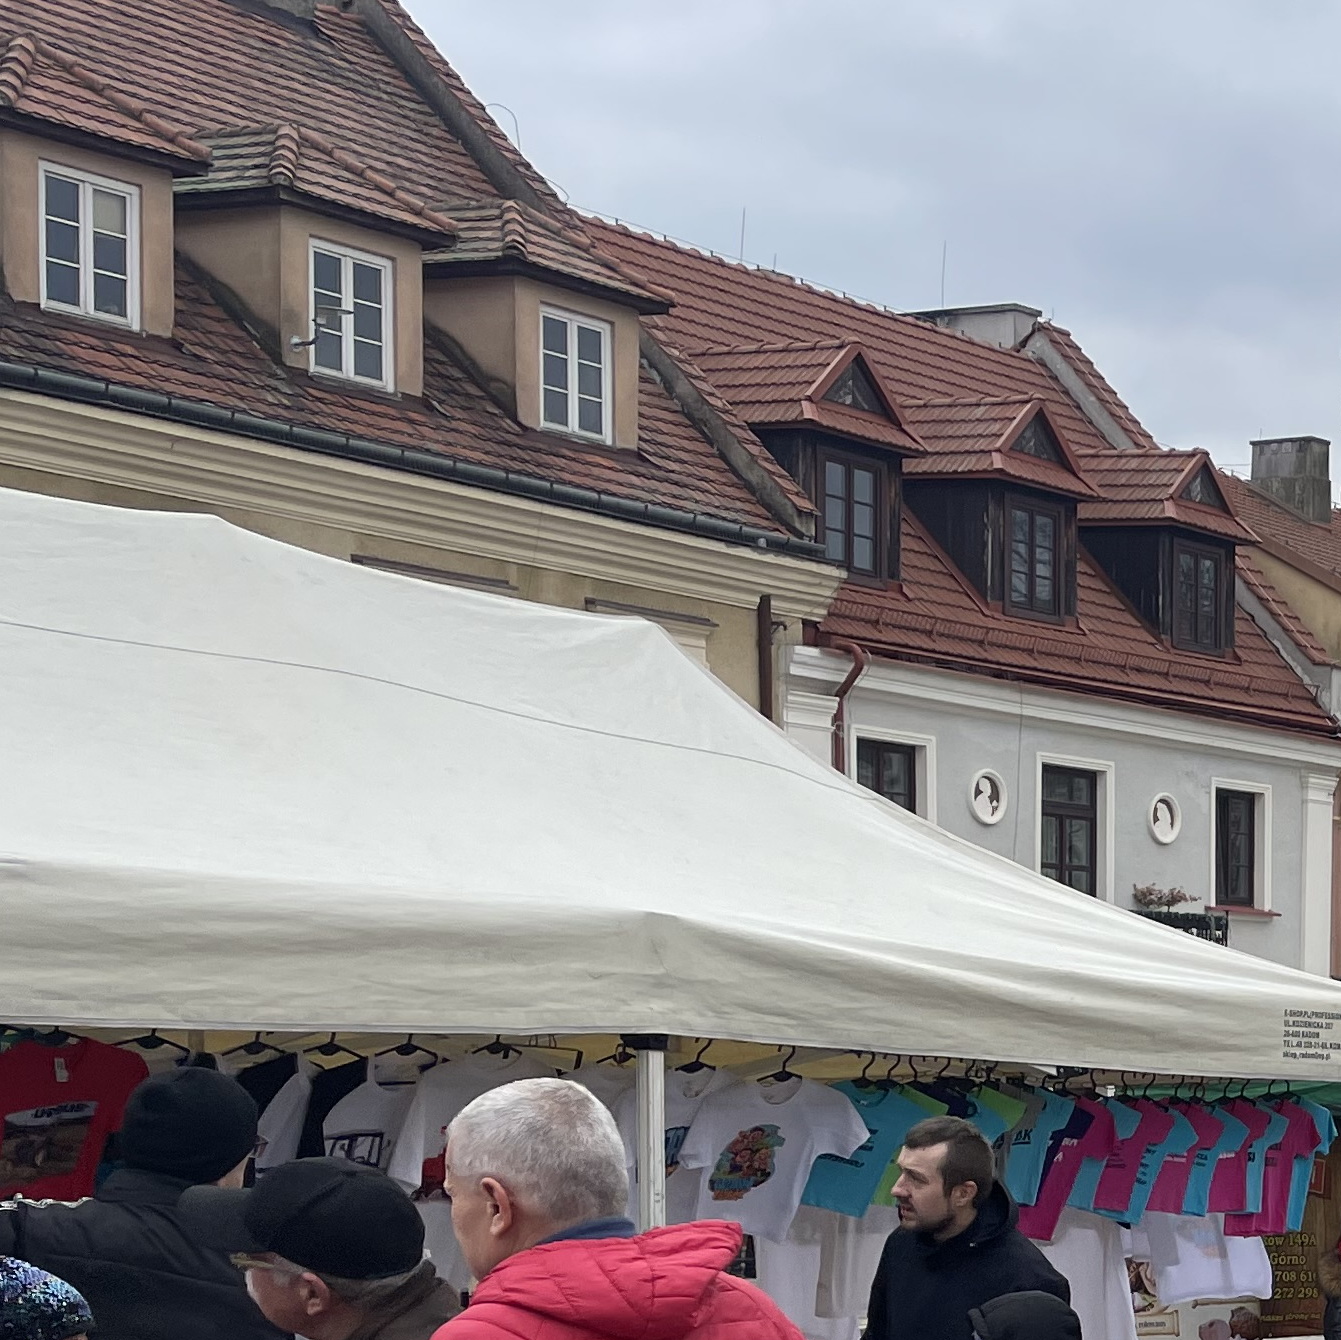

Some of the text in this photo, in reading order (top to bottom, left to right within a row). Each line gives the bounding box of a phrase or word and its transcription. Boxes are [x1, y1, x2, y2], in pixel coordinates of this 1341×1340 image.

[1289, 1233, 1318, 1247] 149A
[1270, 1251, 1307, 1265] Górno
[1275, 1270, 1297, 1282] 708
[1274, 1287, 1295, 1299] 272
